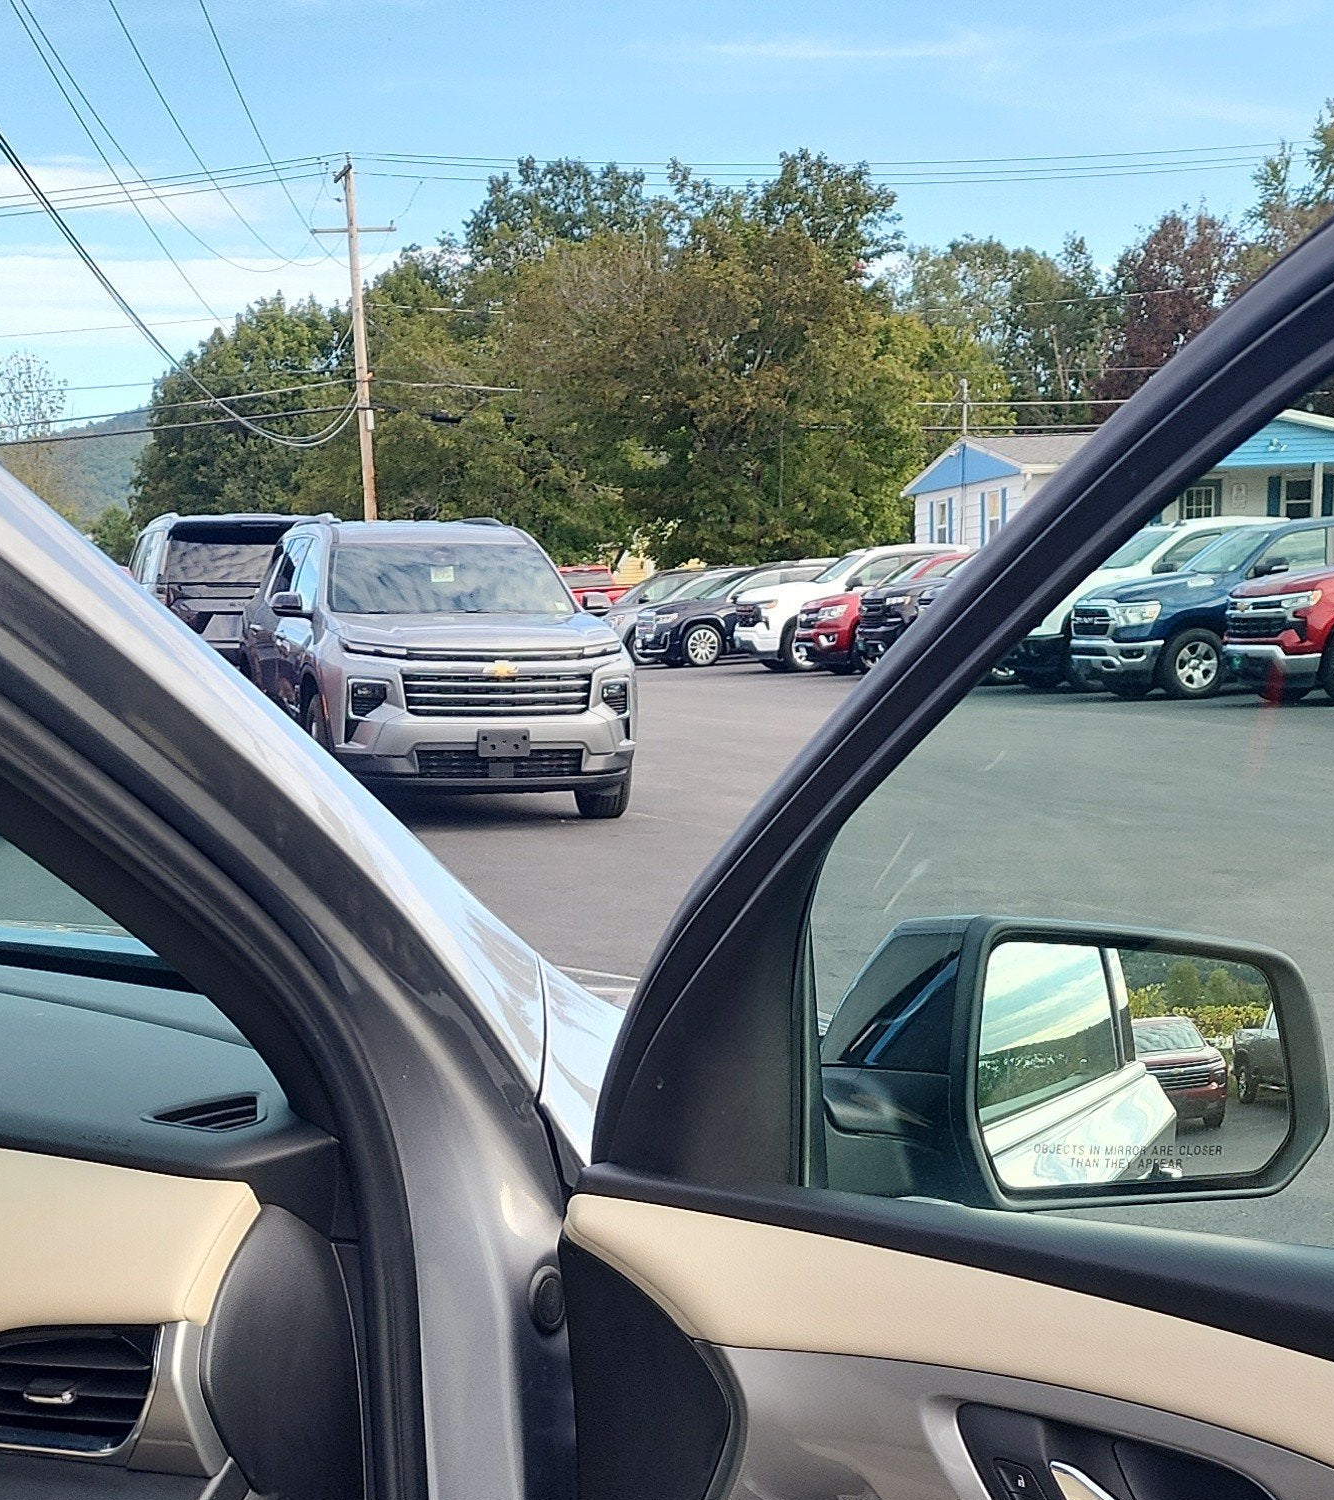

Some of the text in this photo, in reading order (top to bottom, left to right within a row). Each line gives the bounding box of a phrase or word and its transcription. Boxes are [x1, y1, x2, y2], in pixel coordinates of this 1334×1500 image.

[1033, 1143, 1223, 1156] OBJECTS IN MIRROR ARE CLOSER
[1070, 1157, 1183, 1169] THAN THEY APPEAR
